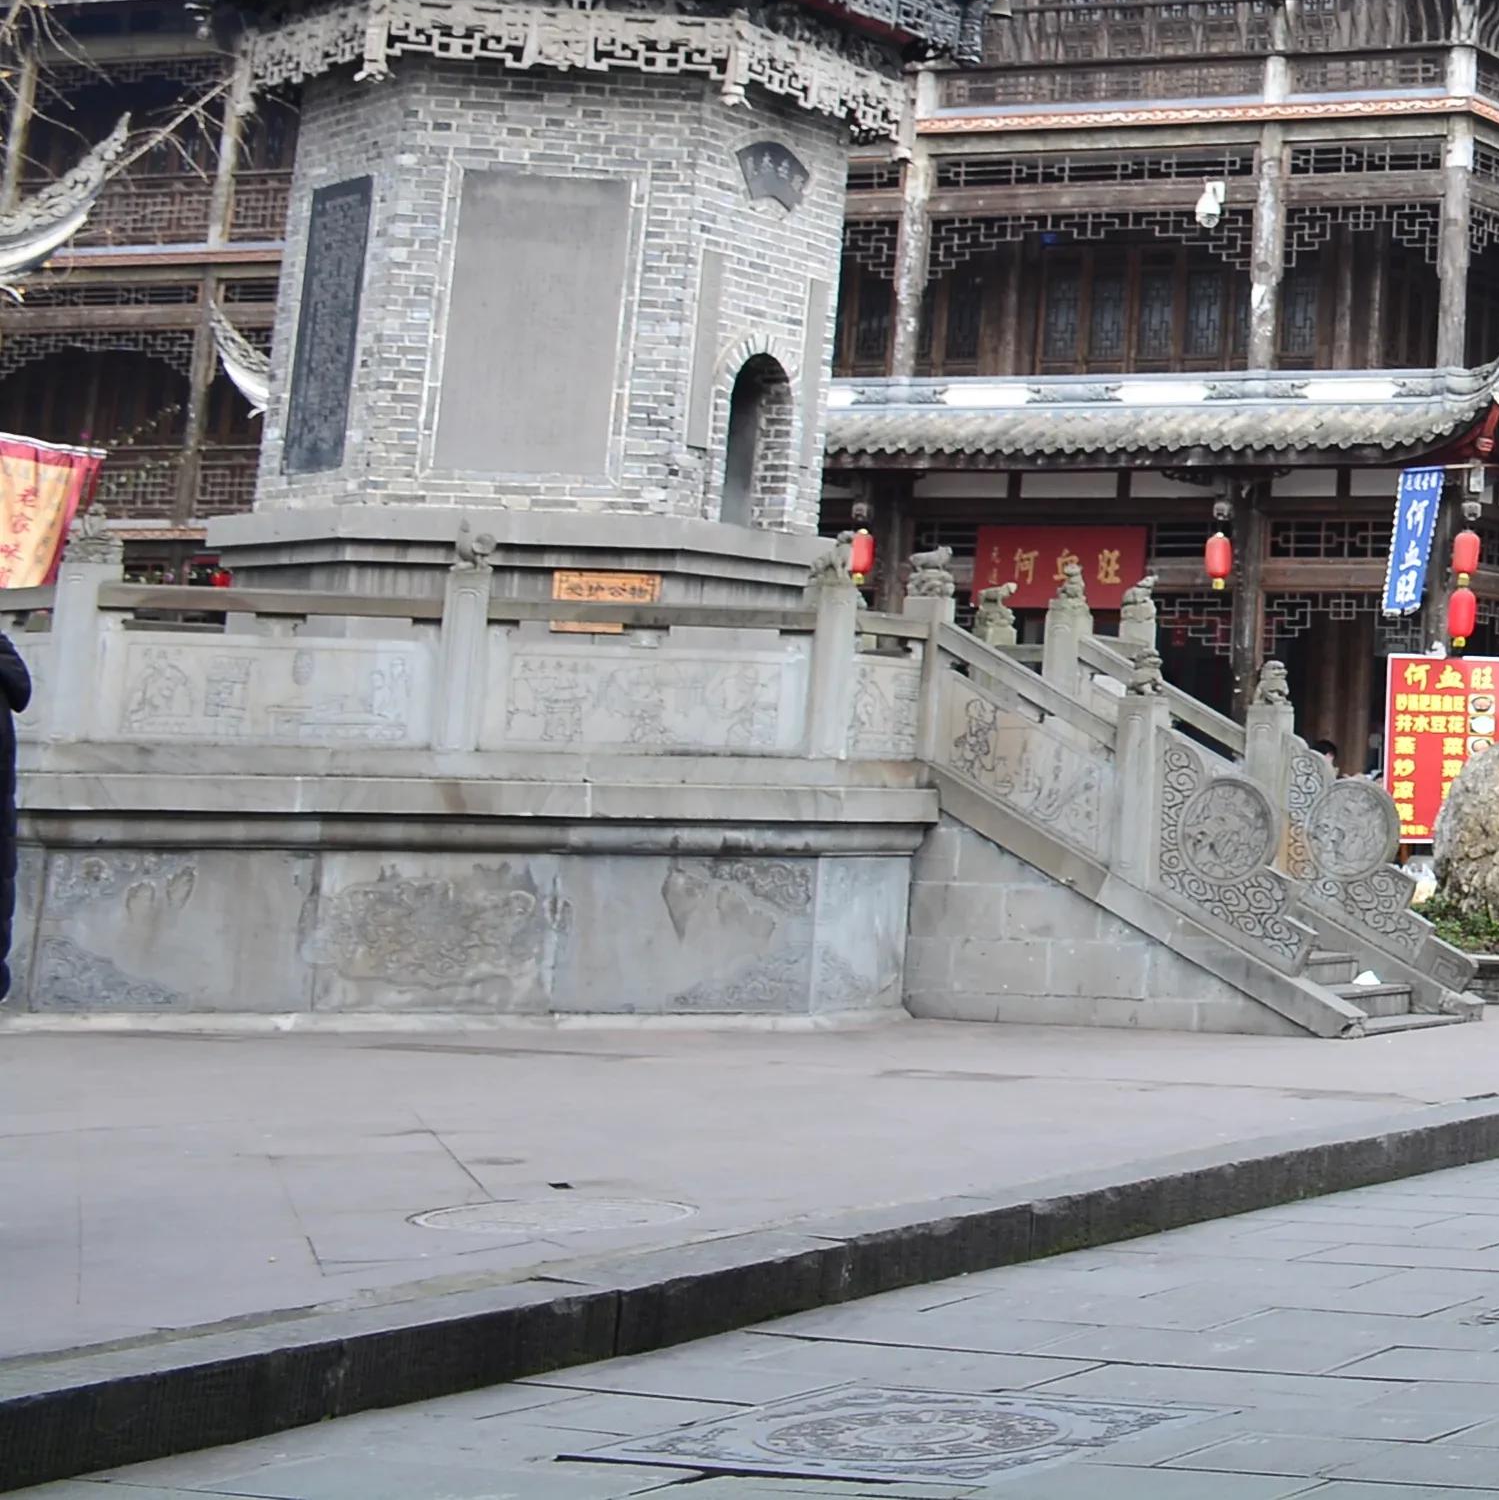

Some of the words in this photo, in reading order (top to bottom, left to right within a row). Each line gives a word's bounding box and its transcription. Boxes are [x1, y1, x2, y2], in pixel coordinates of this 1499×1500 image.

[1395, 499, 1430, 604] 何血旺
[1403, 662, 1496, 692] 何血旺
[1395, 714, 1466, 734] 井水豆花
